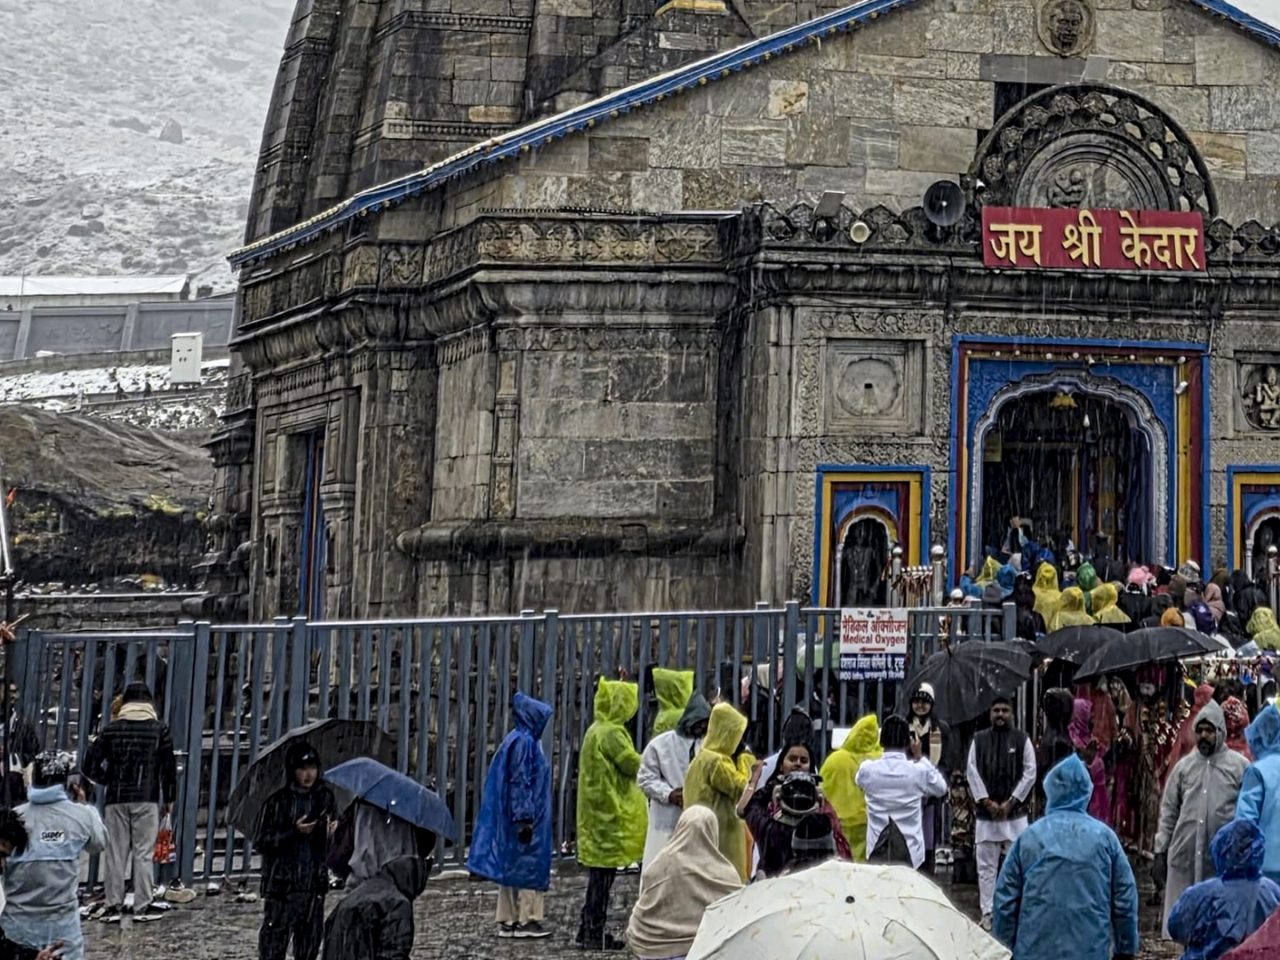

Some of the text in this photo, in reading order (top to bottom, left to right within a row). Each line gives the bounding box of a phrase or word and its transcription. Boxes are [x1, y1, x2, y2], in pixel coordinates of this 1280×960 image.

[990, 209, 1199, 270] जय श्री केदार
[843, 634, 905, 647] Medical Oxygen
